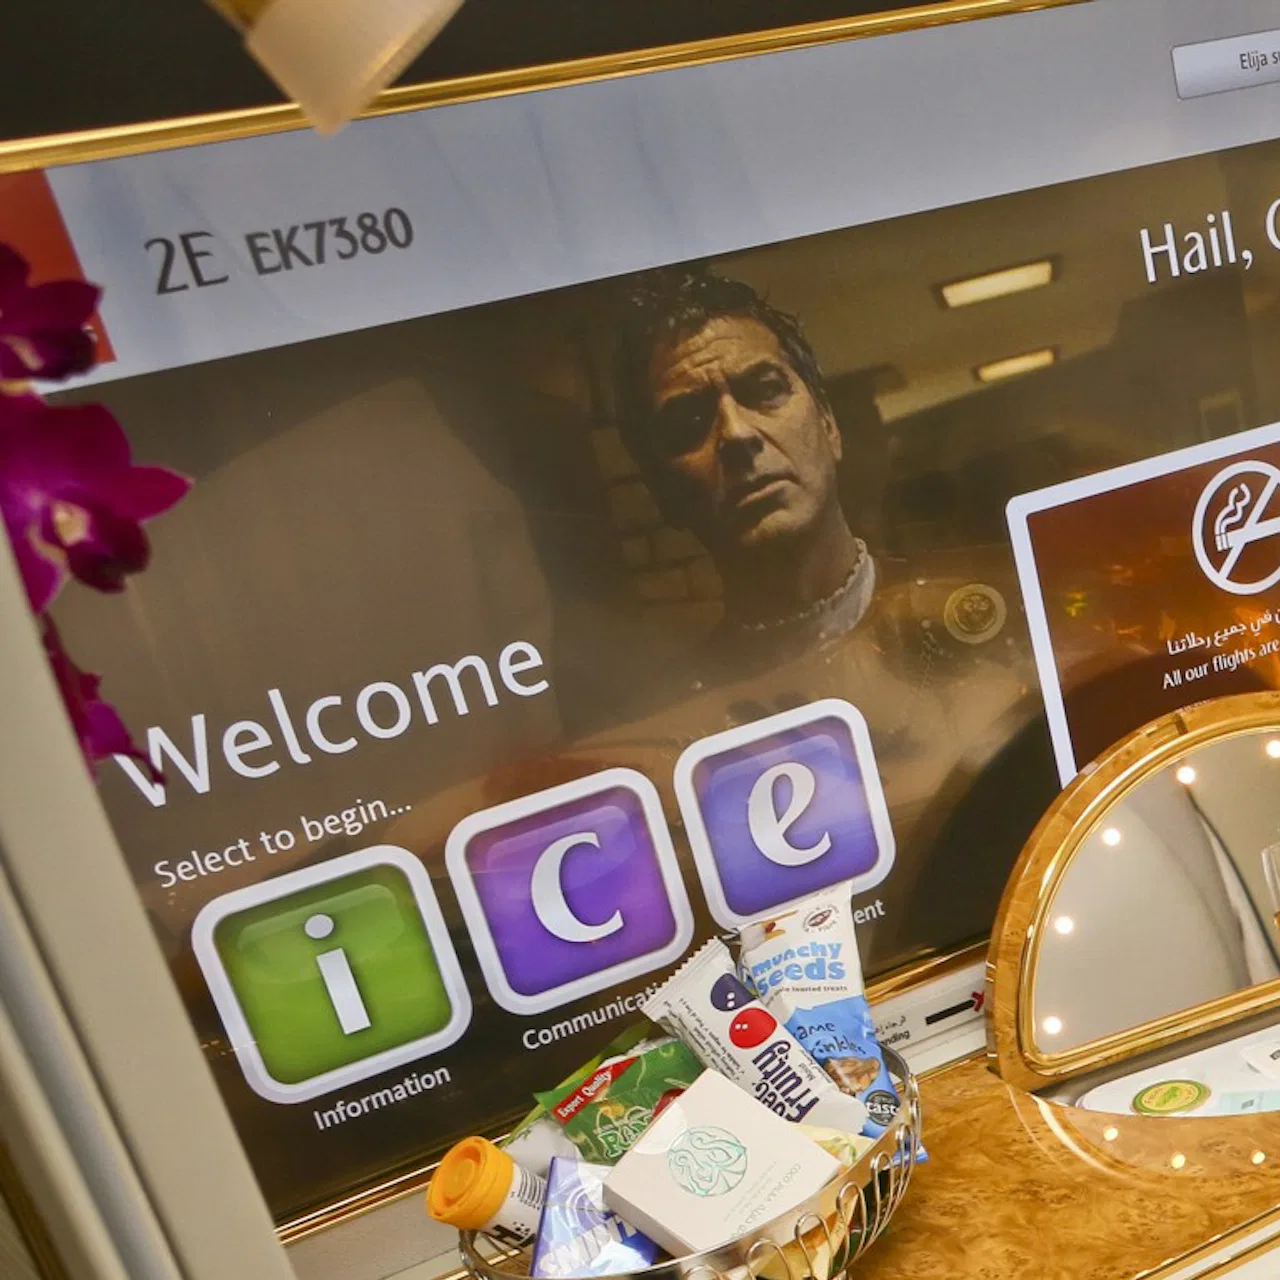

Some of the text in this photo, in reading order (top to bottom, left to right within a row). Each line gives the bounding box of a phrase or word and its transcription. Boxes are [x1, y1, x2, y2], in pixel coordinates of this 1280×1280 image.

[1240, 52, 1268, 71] Elija
[144, 207, 414, 296] 2E EK7380
[1140, 210, 1253, 283] Hail,
[1167, 633, 1211, 656] رحلاتنا
[1213, 623, 1248, 647] جميع
[1250, 610, 1273, 636] في
[1163, 667, 1182, 690] All
[1185, 664, 1209, 682] our
[1212, 646, 1257, 673] flights
[1259, 640, 1280, 658] are
[113, 640, 549, 808] Welcome
[154, 798, 412, 889] Select to begin...
[751, 941, 842, 978] munchy
[756, 958, 846, 996] seeds
[523, 982, 659, 1050] Communicati
[314, 1066, 452, 1132] Information
[557, 1070, 613, 1118] Export Quality
[752, 1039, 820, 1123] Fruity
